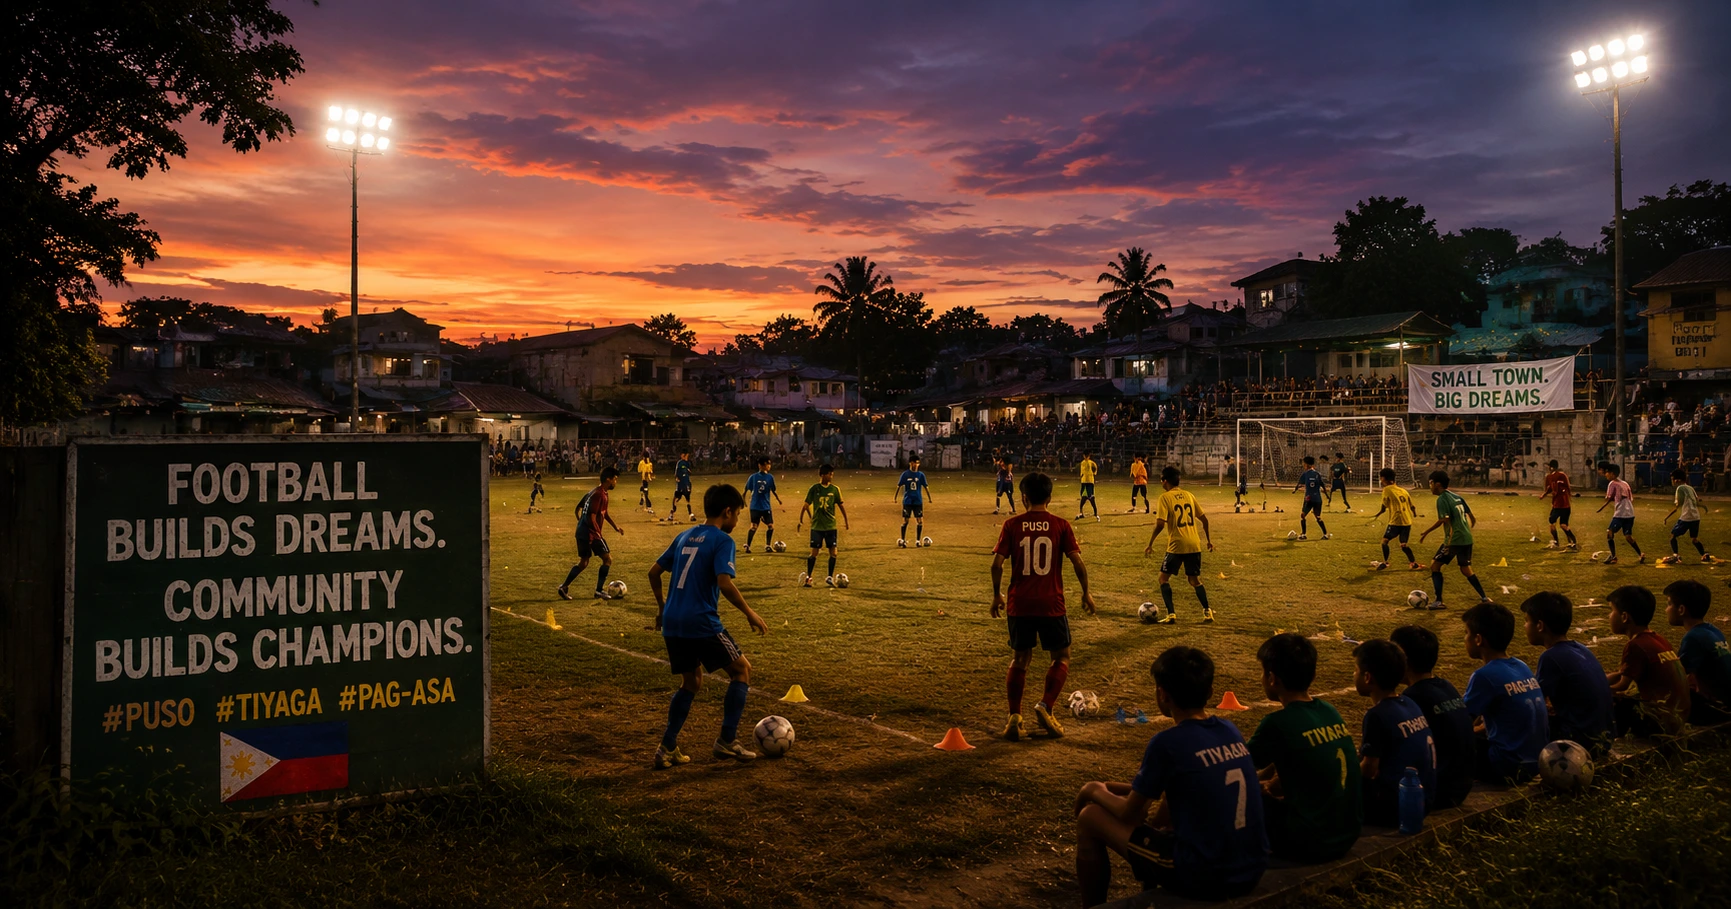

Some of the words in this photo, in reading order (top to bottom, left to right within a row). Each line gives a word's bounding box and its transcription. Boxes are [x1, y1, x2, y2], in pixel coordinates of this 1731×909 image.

[1431, 370, 1486, 388] SMALL
[1493, 366, 1549, 386] TOWN.
[1435, 391, 1462, 409] BIG
[1469, 388, 1546, 408] DREAMS.
[168, 461, 378, 505] FOOTBALL
[106, 514, 256, 562] BUILDS
[275, 509, 446, 555] DREAMS.
[1022, 521, 1050, 532] PUSO
[1174, 503, 1194, 527] 23
[676, 546, 699, 590] 7
[1019, 535, 1053, 576] 10
[164, 569, 403, 622] COMMUNITY
[95, 631, 239, 682] BUILDS
[252, 616, 473, 669] CHAMPIONS.
[102, 697, 196, 734] #PUSO
[216, 687, 323, 723] #TIYAGA
[339, 677, 456, 712] #PAG-ASA
[1335, 747, 1347, 790] 1
[1224, 767, 1247, 830] 7
